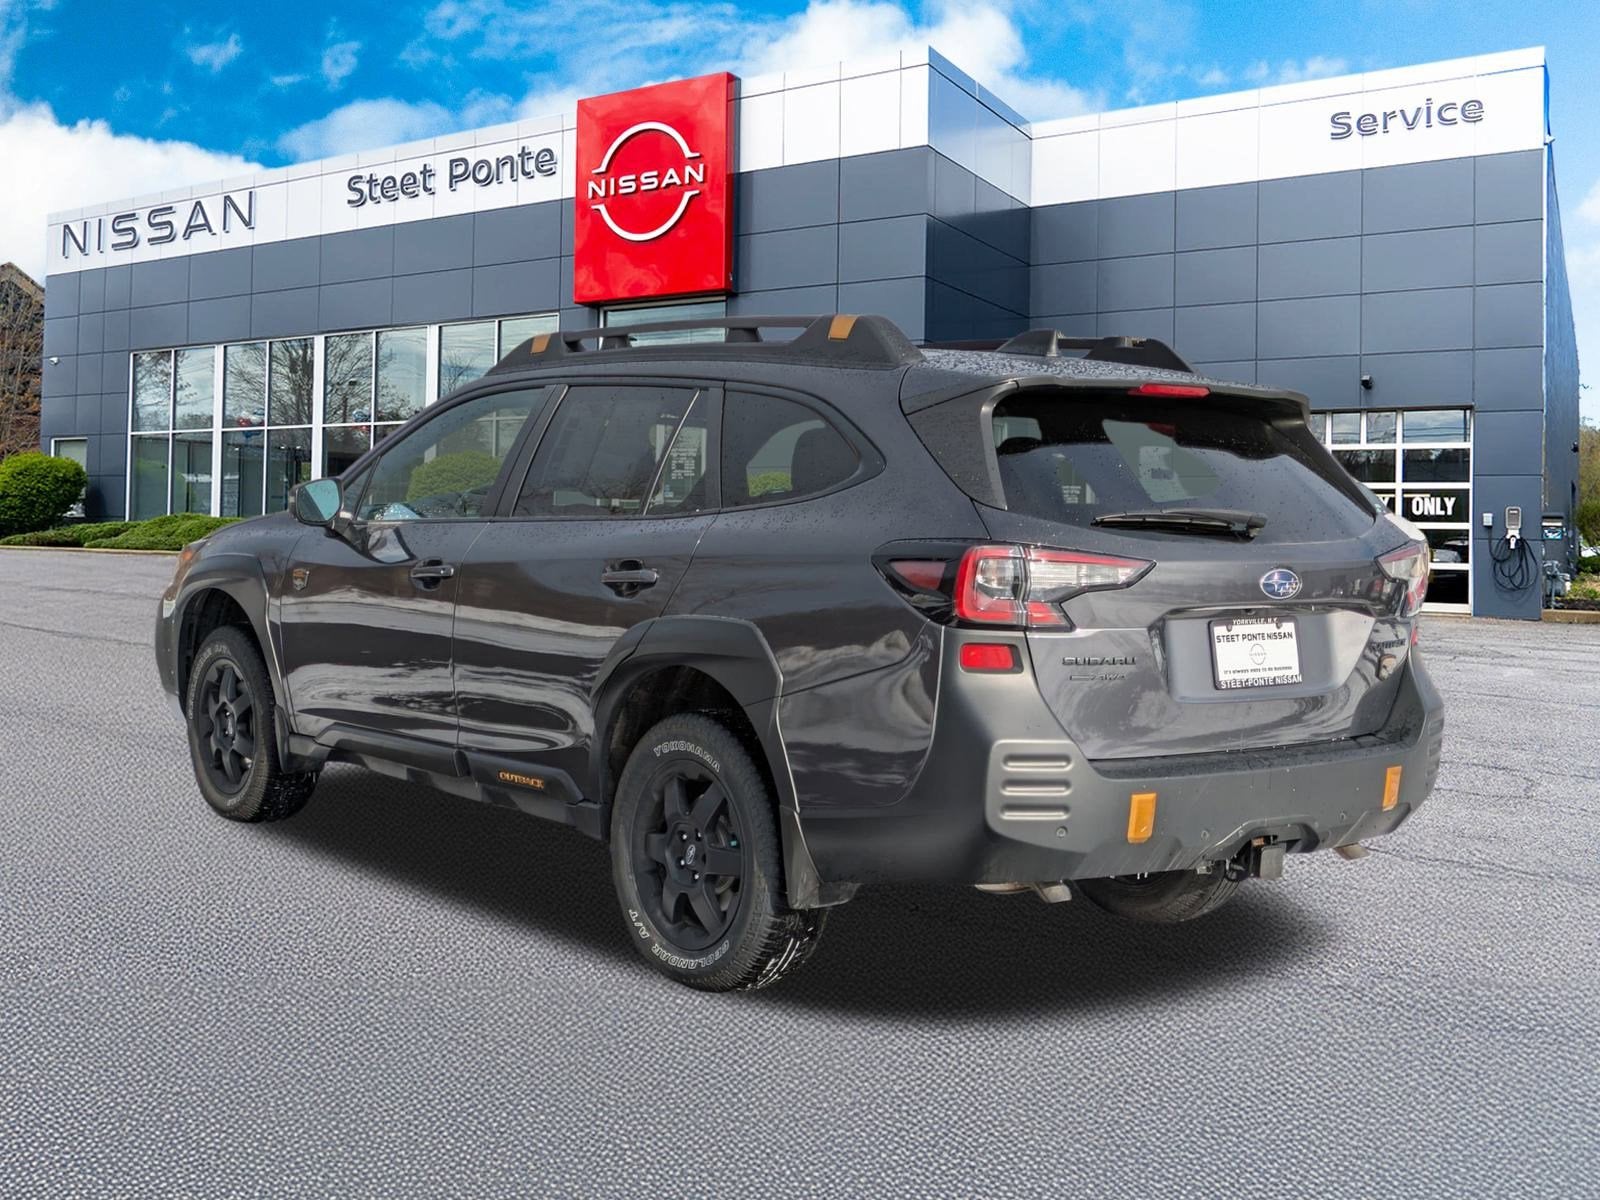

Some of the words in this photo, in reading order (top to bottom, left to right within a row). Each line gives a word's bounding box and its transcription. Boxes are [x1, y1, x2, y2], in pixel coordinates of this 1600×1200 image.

[1330, 98, 1485, 140] Service
[346, 164, 435, 208] Steet
[448, 145, 558, 192] Ponte
[588, 164, 705, 201] NISSAN
[62, 190, 255, 259] NISSAN
[1411, 496, 1456, 516] ONLY
[1216, 634, 1240, 643] STEET
[1241, 632, 1265, 642] PONTE
[1266, 631, 1293, 641] NISSAN
[1062, 656, 1137, 666] SUBARU
[1274, 673, 1302, 685] NISSAN
[653, 740, 721, 773] YOKOHAMA
[498, 771, 545, 790] OUTBACK
[651, 939, 730, 970] GEOLANDAR
